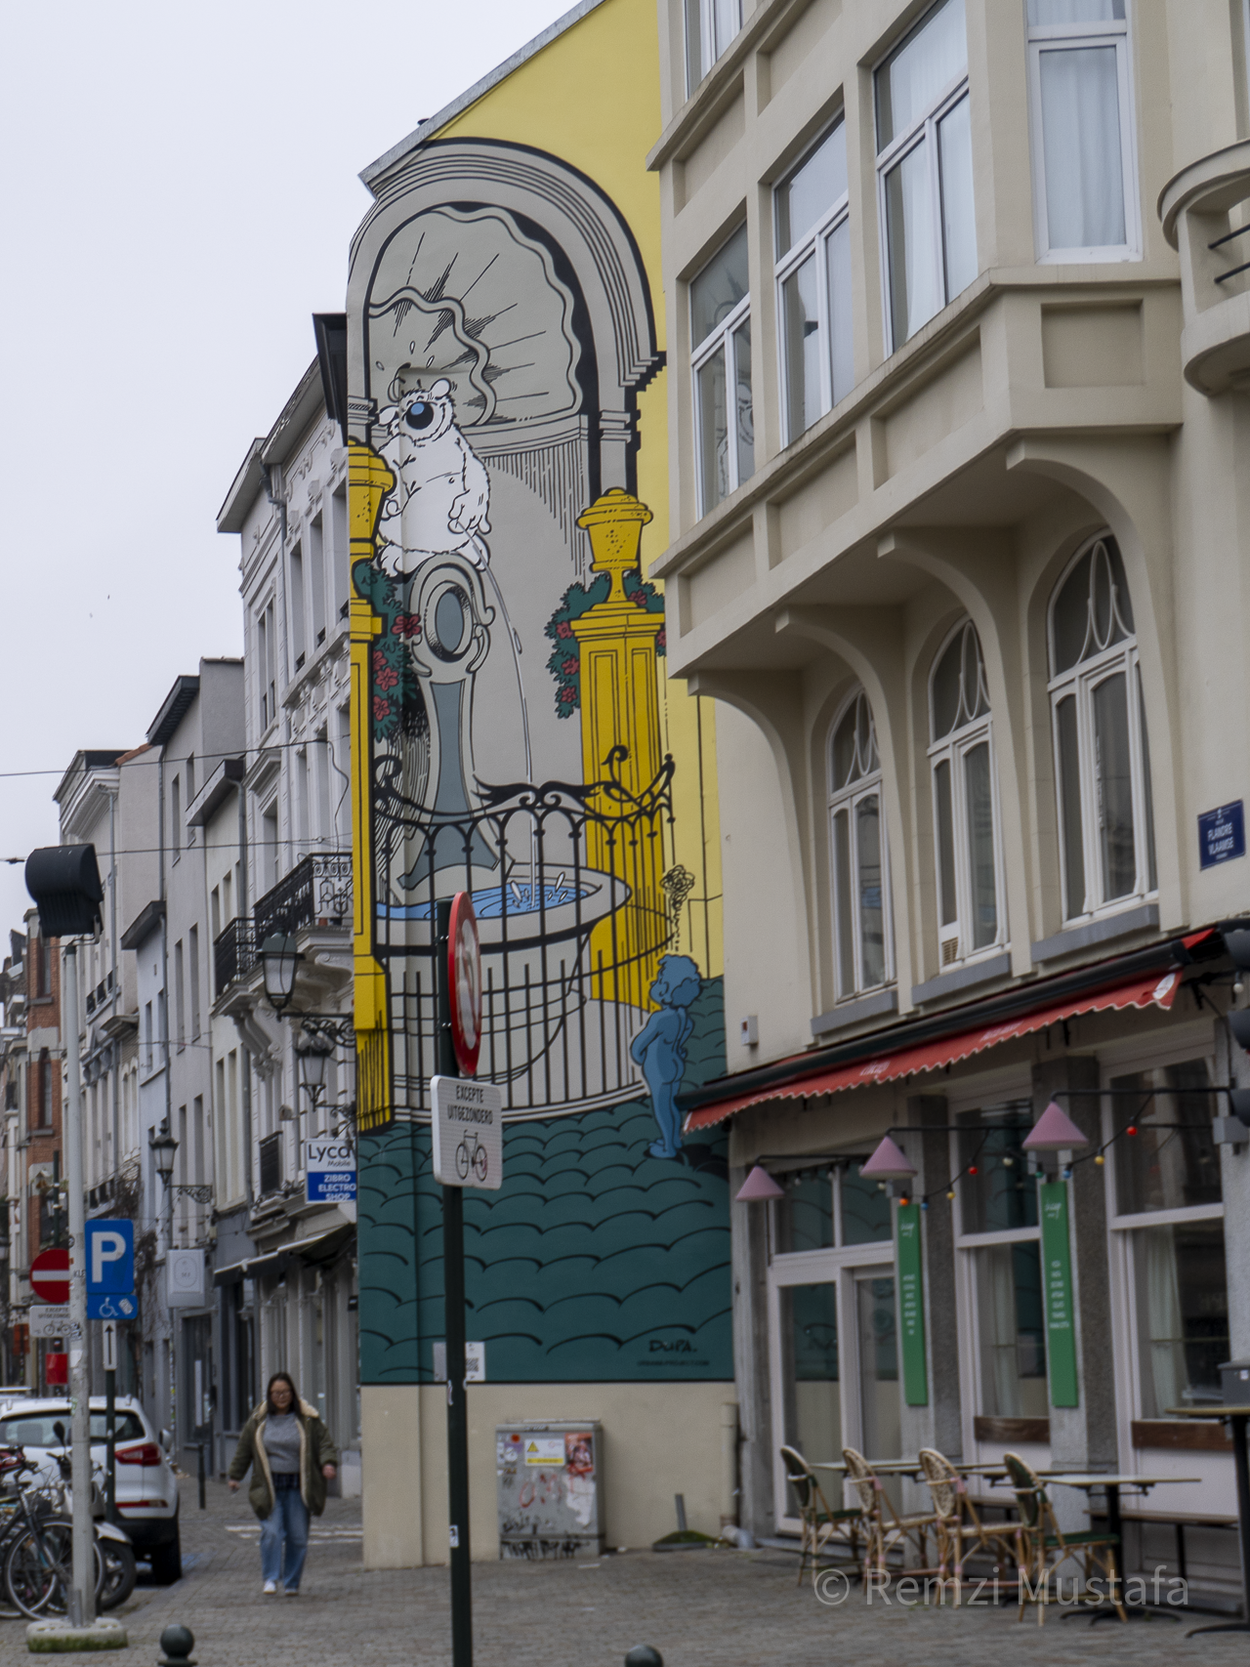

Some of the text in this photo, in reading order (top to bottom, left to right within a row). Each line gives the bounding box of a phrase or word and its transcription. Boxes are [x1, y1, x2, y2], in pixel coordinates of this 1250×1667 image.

[456, 1085, 484, 1104] EXCEPTE
[447, 1104, 493, 1125] UITGEZONDERD
[308, 1143, 351, 1163] Lyca
[318, 1182, 357, 1192] ELECTRO
[324, 1173, 352, 1183] ZIBRO
[325, 1192, 351, 1202] SHOP
[91, 1231, 127, 1283] P
